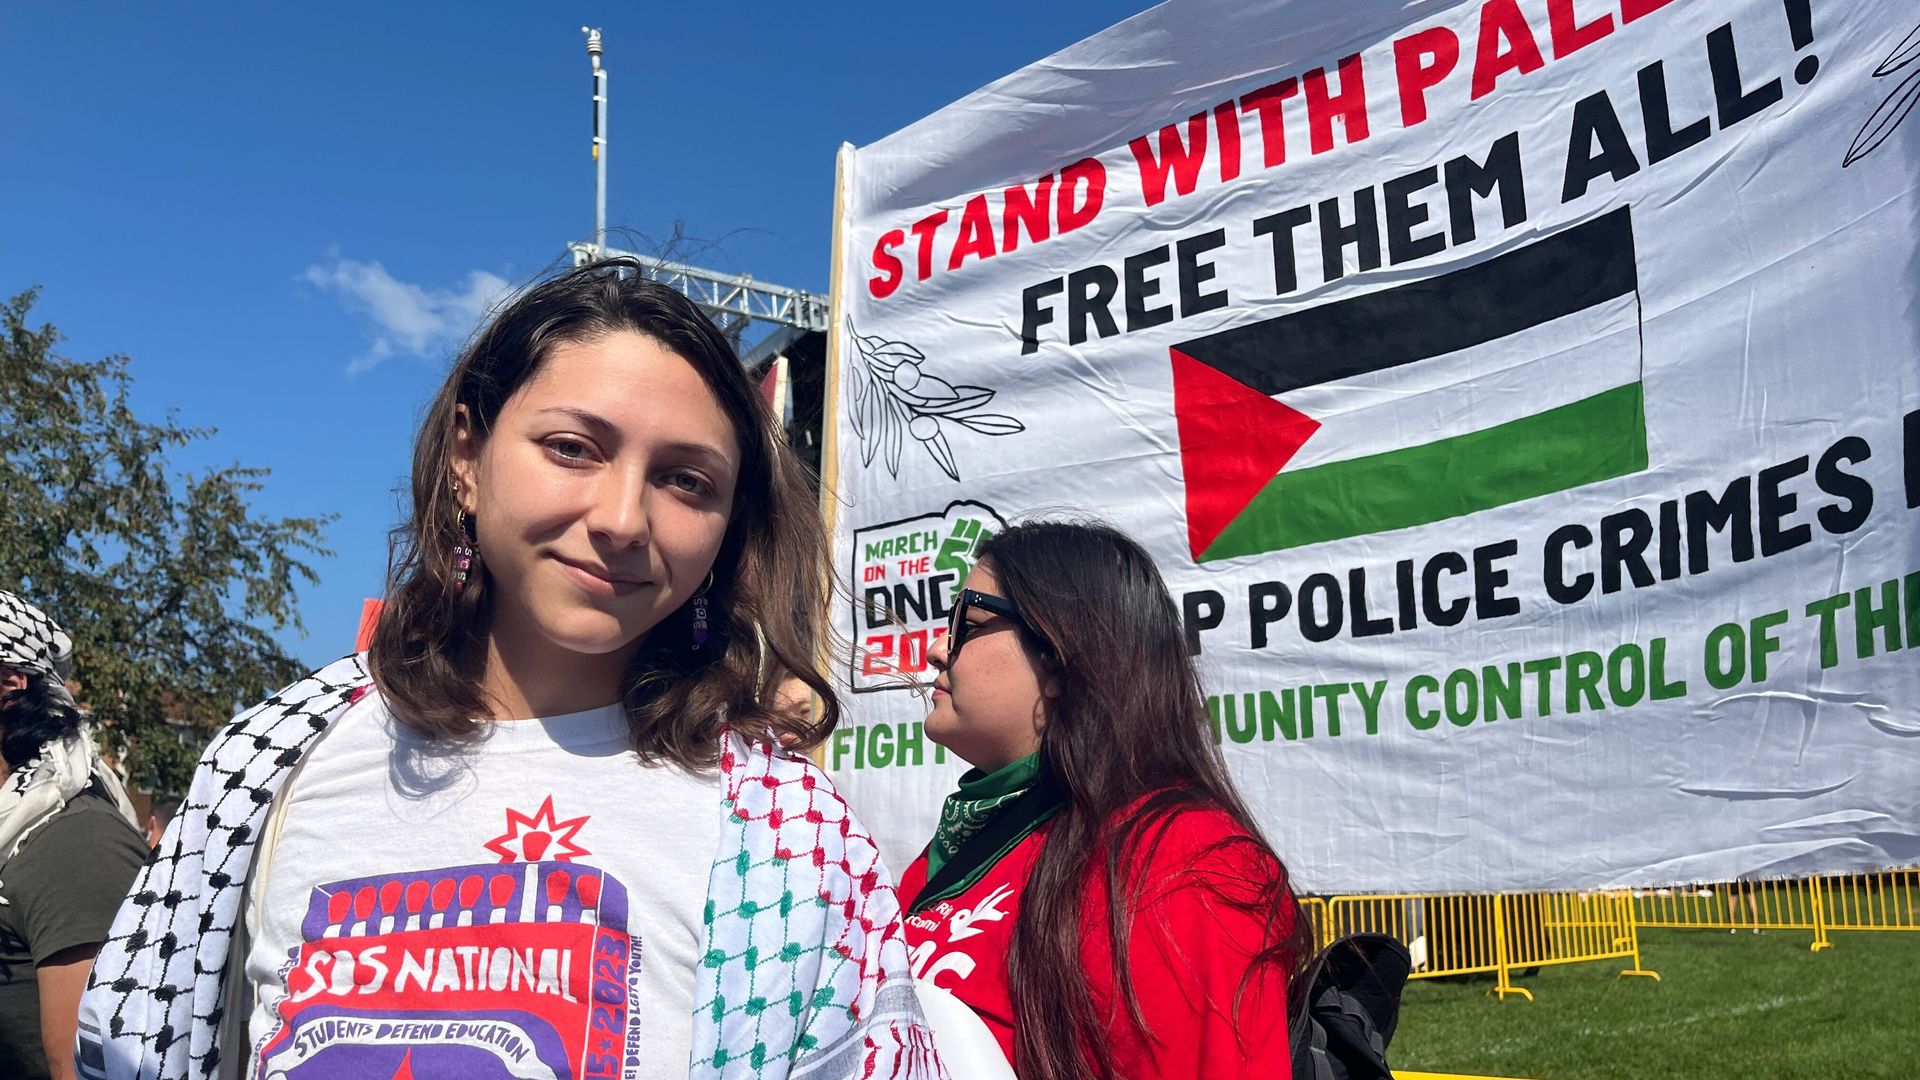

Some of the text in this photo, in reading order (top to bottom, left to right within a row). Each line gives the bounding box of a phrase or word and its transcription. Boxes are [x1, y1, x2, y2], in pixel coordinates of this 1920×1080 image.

[869, 0, 1675, 299] STAND WITH PAL
[1020, 0, 1820, 356] FREE THEM ALL!
[864, 556, 930, 583] ON THE
[865, 530, 938, 562] MARCH
[1249, 539, 1520, 650] POLICE
[1543, 436, 1873, 605] CRIMES
[864, 573, 955, 629] DNC
[862, 627, 949, 677] 20
[1405, 637, 1687, 732] CONTROL
[1703, 610, 1789, 690] OF
[395, 946, 578, 1004] NATIONAL
[592, 934, 627, 1035] 2023
[294, 1020, 373, 1057] STUDENTS
[375, 1022, 443, 1040] DEFEND
[444, 1023, 530, 1064] EDUCATION
[625, 1016, 641, 1066] DEFEND
